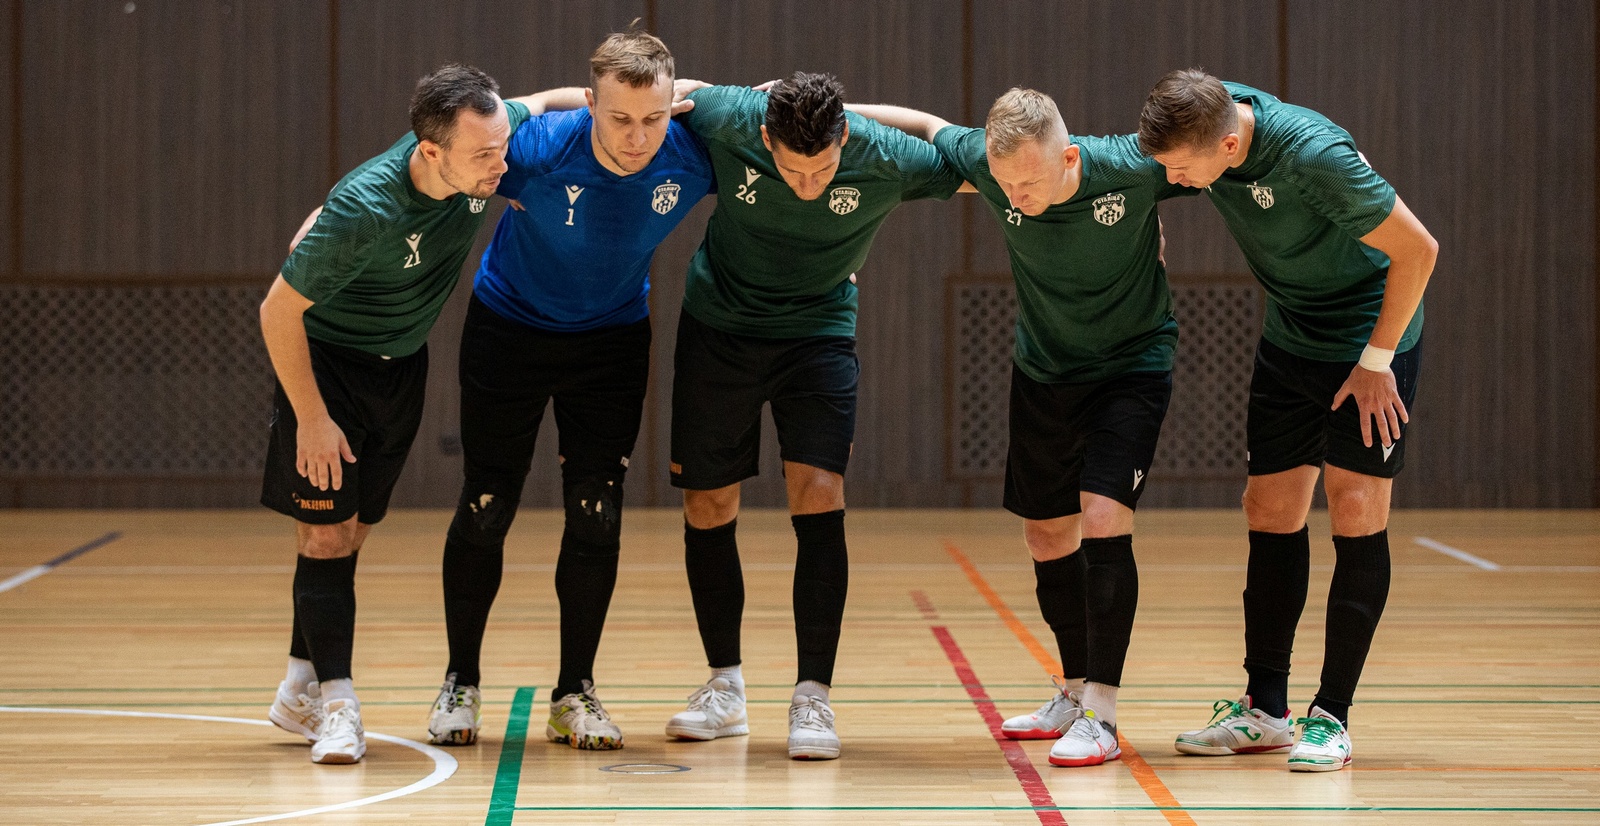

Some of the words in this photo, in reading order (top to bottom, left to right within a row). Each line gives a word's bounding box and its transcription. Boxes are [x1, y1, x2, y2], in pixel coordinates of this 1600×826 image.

[735, 184, 757, 205] 26
[565, 208, 574, 226] 1
[1005, 209, 1023, 226] 27
[403, 250, 421, 269] 21
